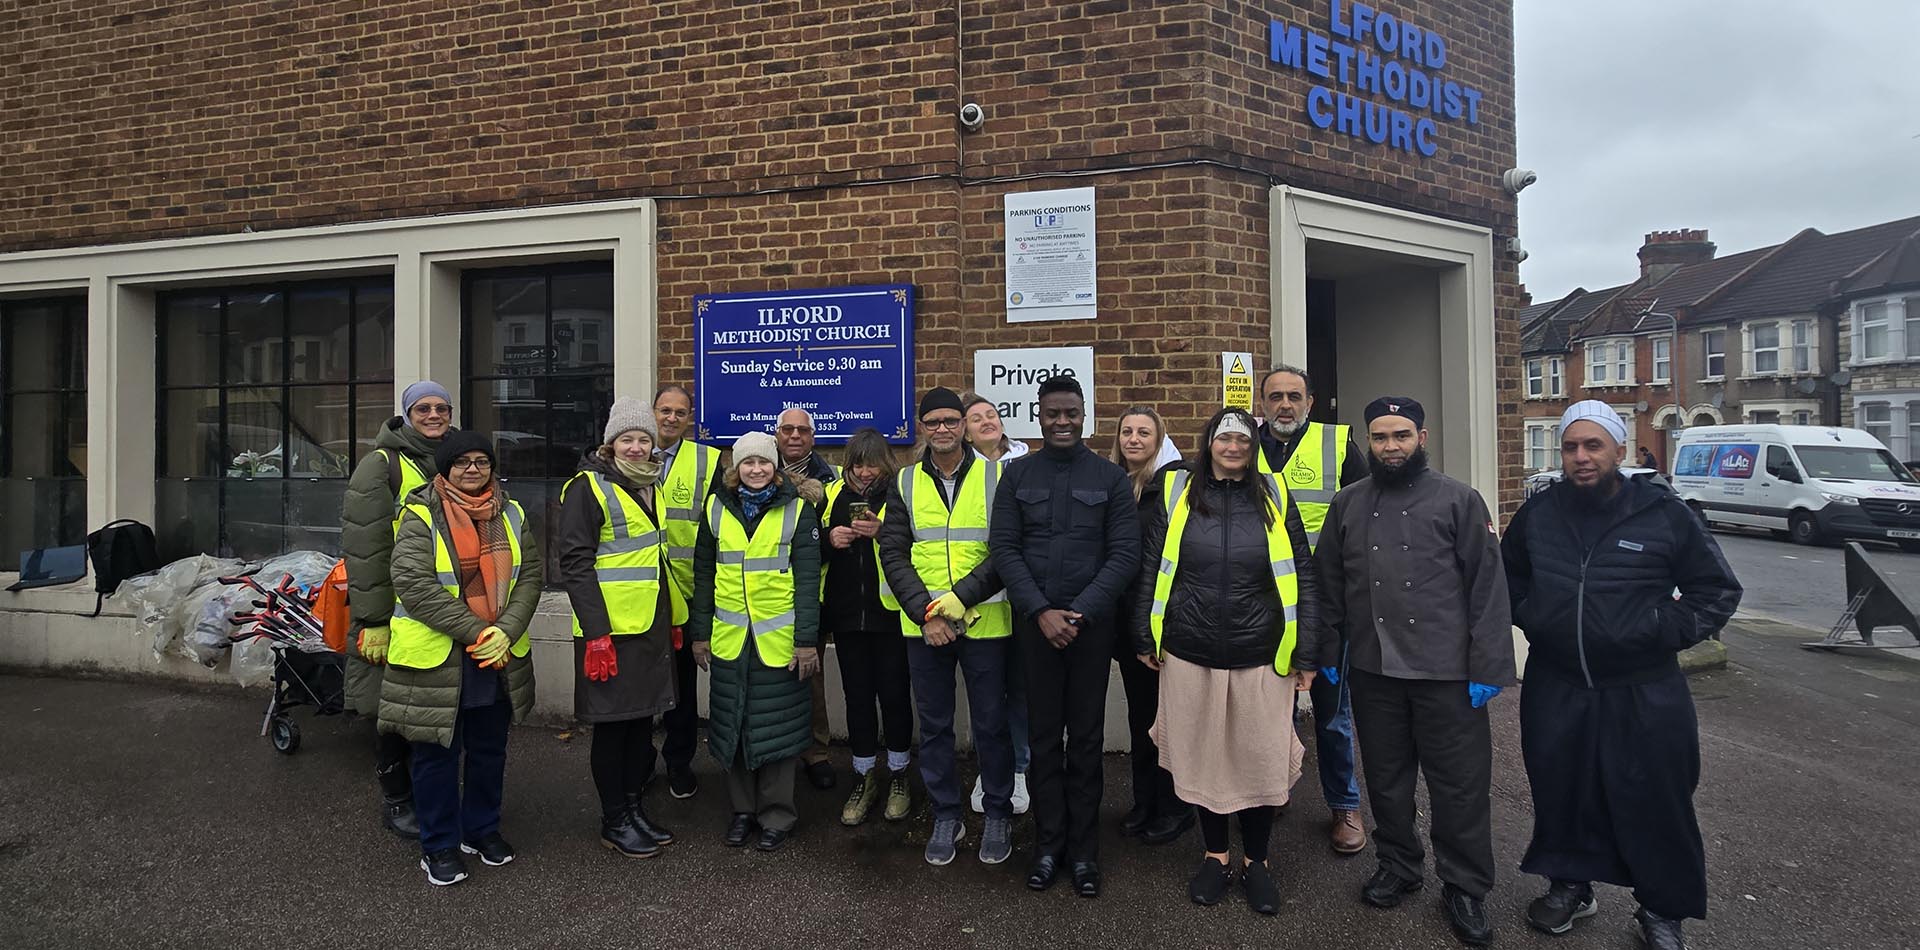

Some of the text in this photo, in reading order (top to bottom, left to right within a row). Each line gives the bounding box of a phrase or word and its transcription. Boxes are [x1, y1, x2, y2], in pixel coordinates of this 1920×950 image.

[1331, 0, 1446, 69] LFORD
[1270, 20, 1482, 124] METHODIST
[1307, 85, 1438, 157] CHURC
[1010, 205, 1091, 217] PARKING CONDITIONS
[757, 305, 843, 326] ILFORD
[713, 325, 891, 344] METHODIST CHURCH
[721, 357, 882, 376] Sunday Service 9.30 am
[991, 364, 1076, 385] Private
[759, 376, 841, 387] & As Announced
[782, 401, 818, 410] Minister
[997, 402, 1021, 418] ar
[730, 413, 751, 421] Revd
[753, 412, 778, 421] Mmas
[1224, 416, 1233, 427] T
[818, 422, 837, 431] 3533
